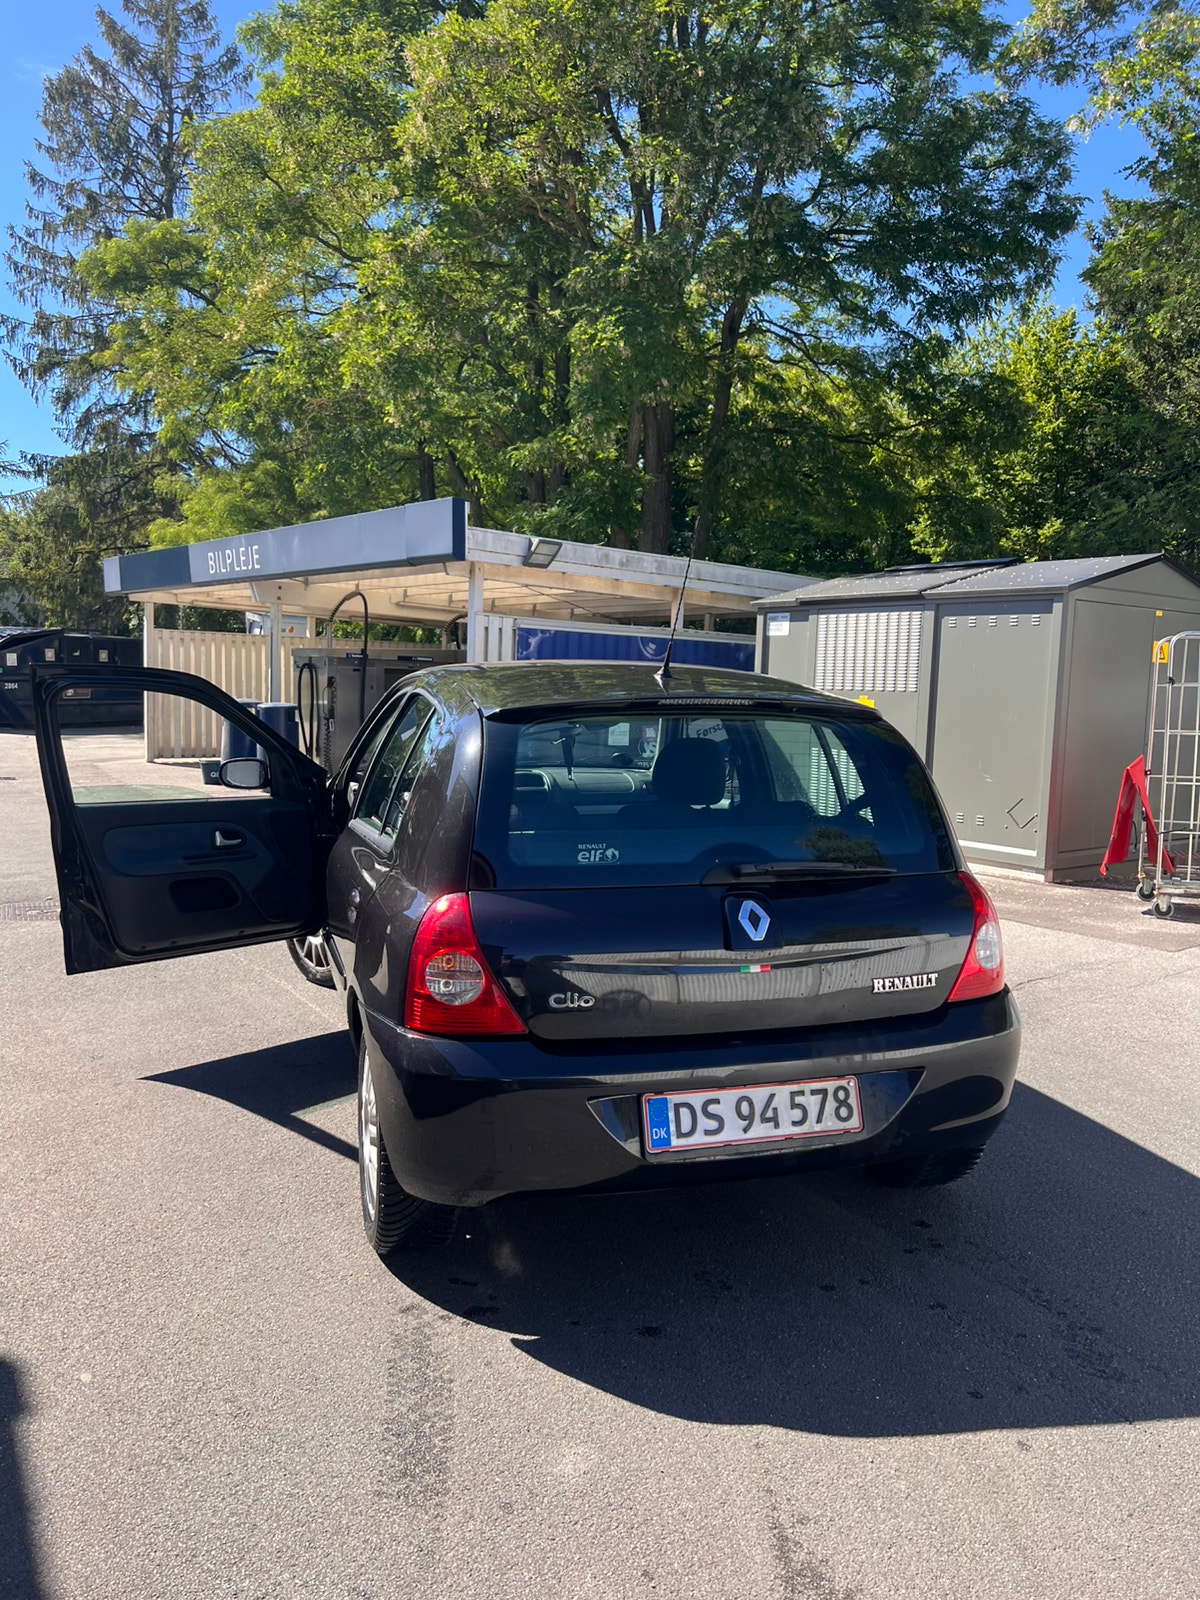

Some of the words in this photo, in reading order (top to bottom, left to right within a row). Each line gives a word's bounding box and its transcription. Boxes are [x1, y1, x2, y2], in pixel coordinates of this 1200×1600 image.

[207, 545, 261, 575] BILPLEJE
[577, 849, 604, 862] elf
[873, 973, 939, 993] RENAULT
[673, 1098, 725, 1139] DS
[652, 1127, 668, 1140] DK
